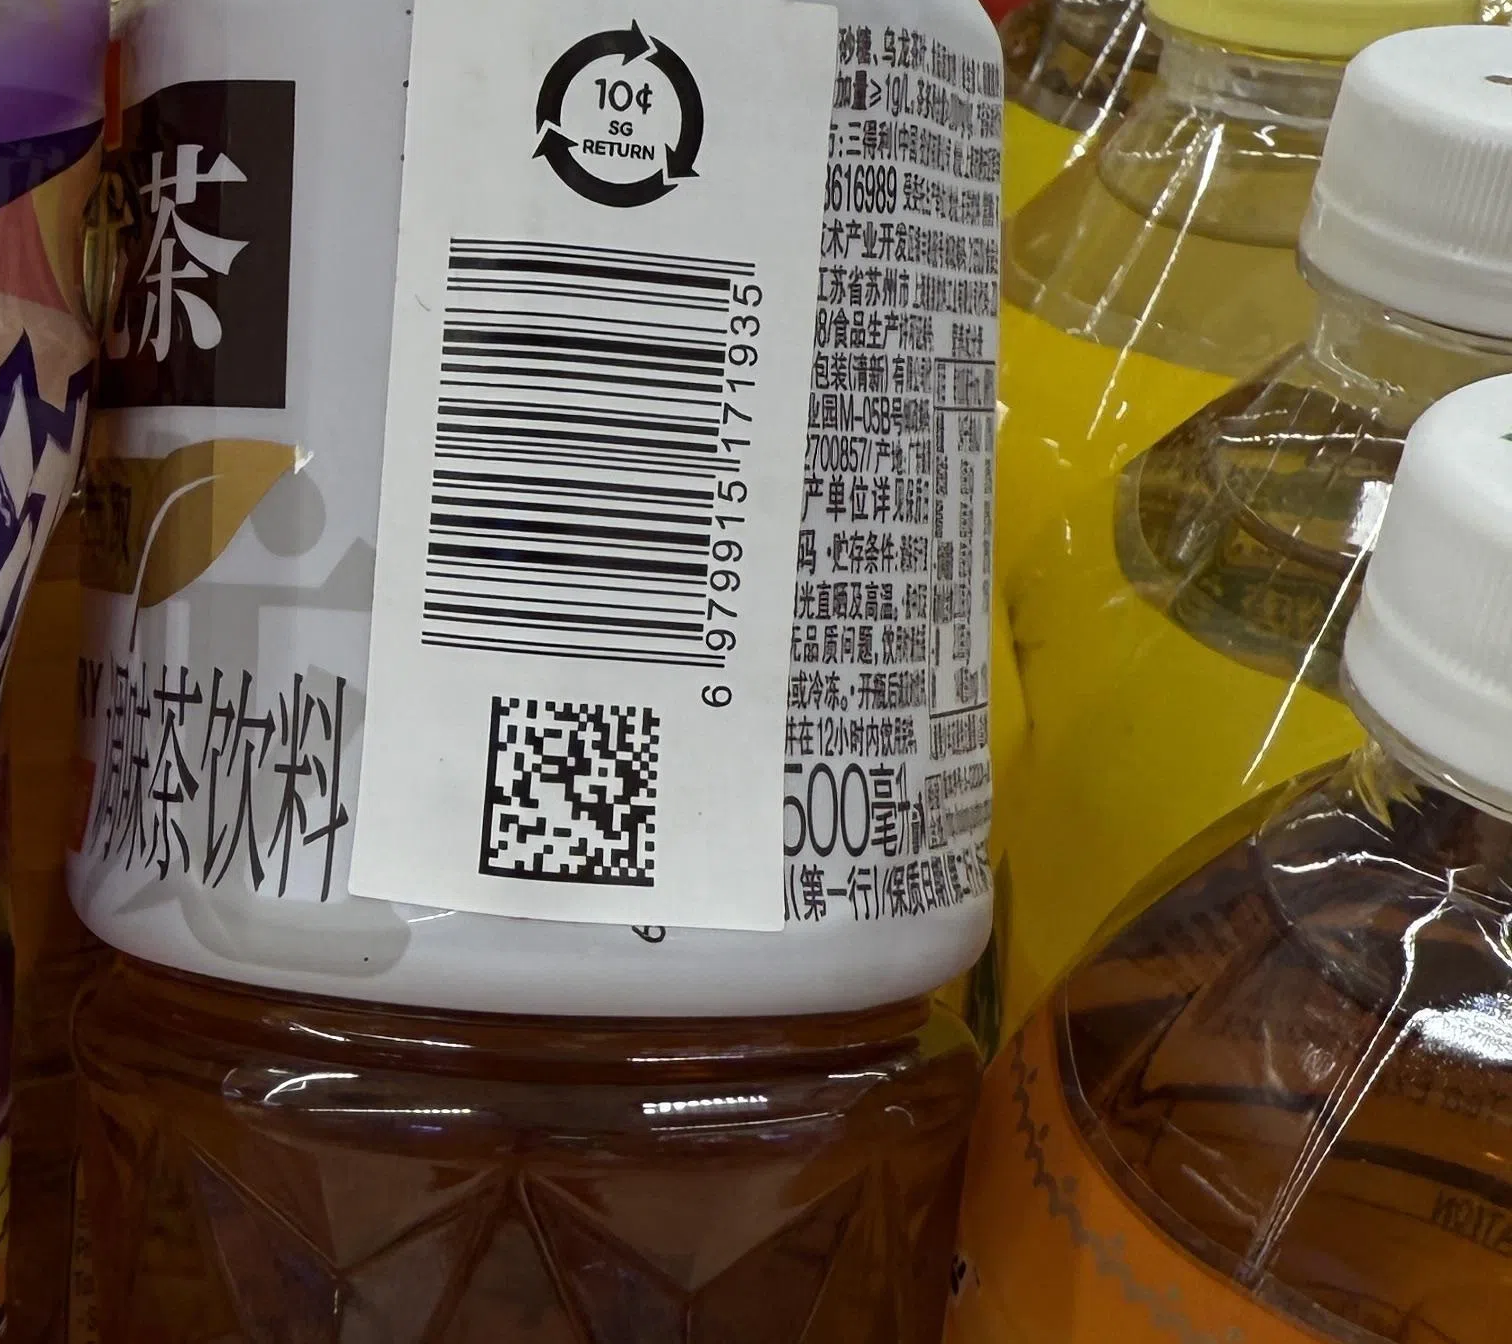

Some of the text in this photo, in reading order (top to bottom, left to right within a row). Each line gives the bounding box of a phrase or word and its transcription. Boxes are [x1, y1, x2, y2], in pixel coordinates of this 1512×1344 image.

[594, 77, 653, 114] 10¢
[608, 119, 634, 137] SG
[582, 139, 655, 161] RETURN
[137, 143, 251, 362] 茶
[701, 283, 763, 708] 6 979915 171935
